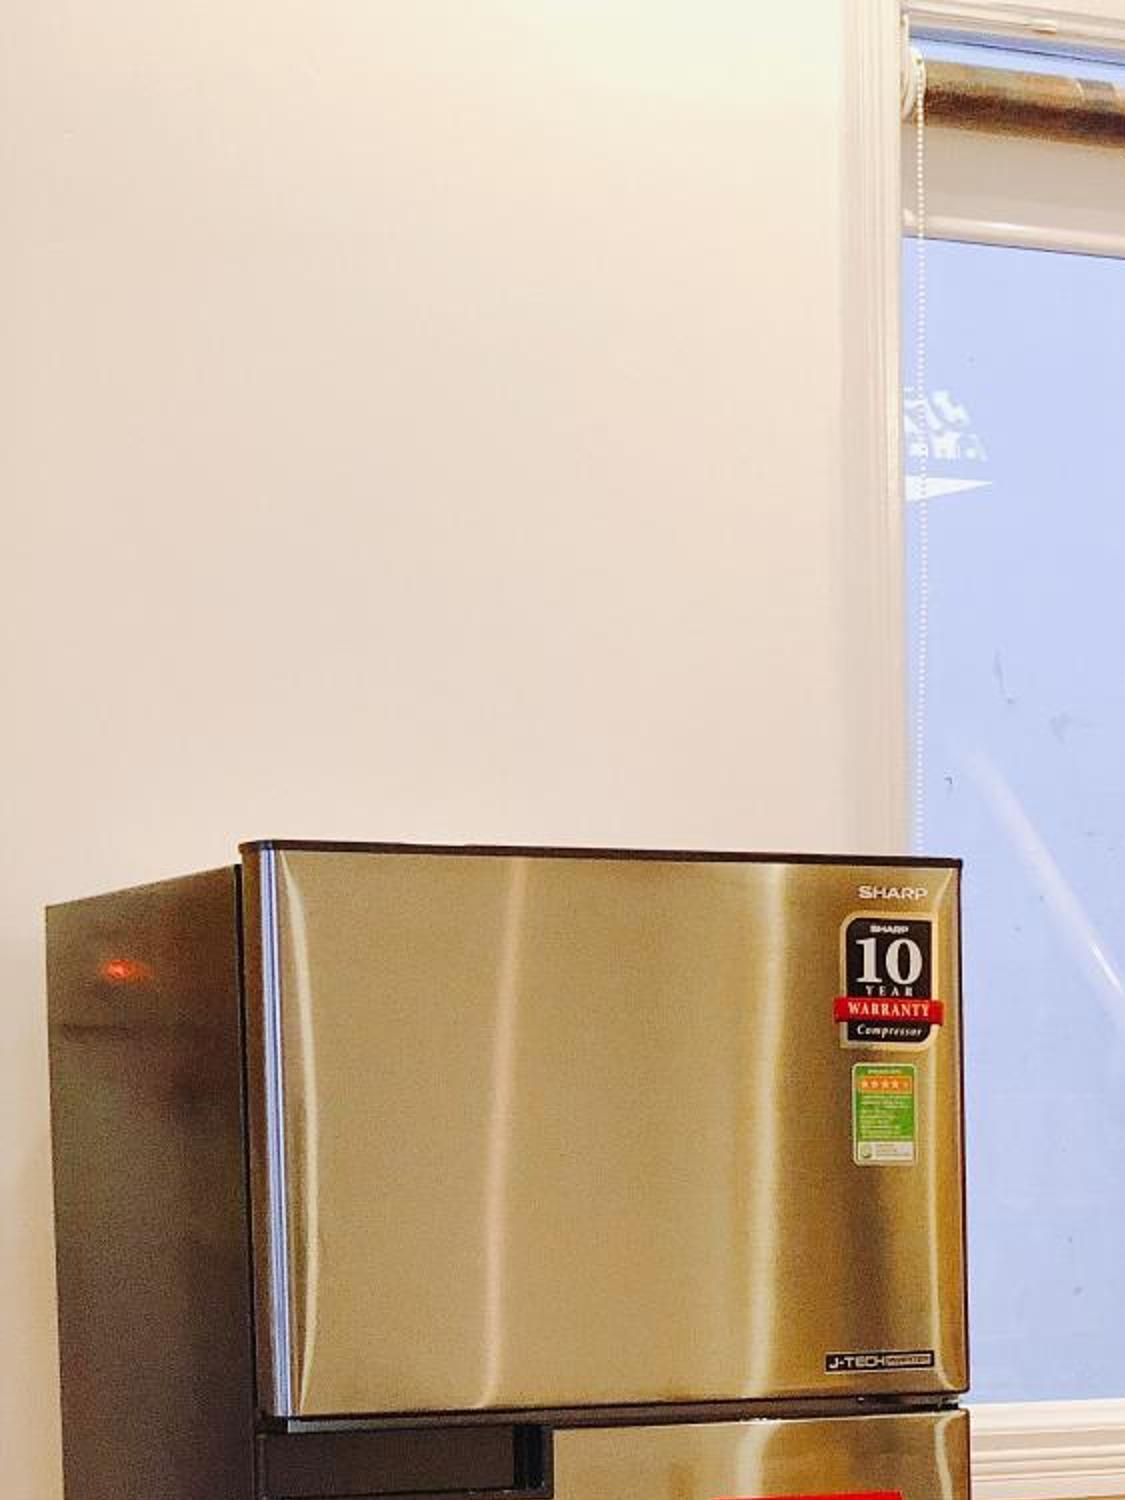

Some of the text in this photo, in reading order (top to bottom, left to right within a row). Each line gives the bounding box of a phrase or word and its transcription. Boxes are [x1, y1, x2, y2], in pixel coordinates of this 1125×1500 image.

[858, 885, 929, 900] SHARP
[869, 924, 909, 934] SHARP
[856, 937, 923, 985] 10
[865, 985, 913, 997] YEAR
[847, 1001, 929, 1017] WARRANTY
[857, 1023, 922, 1039] Compressor
[829, 1355, 885, 1369] J-TECH
